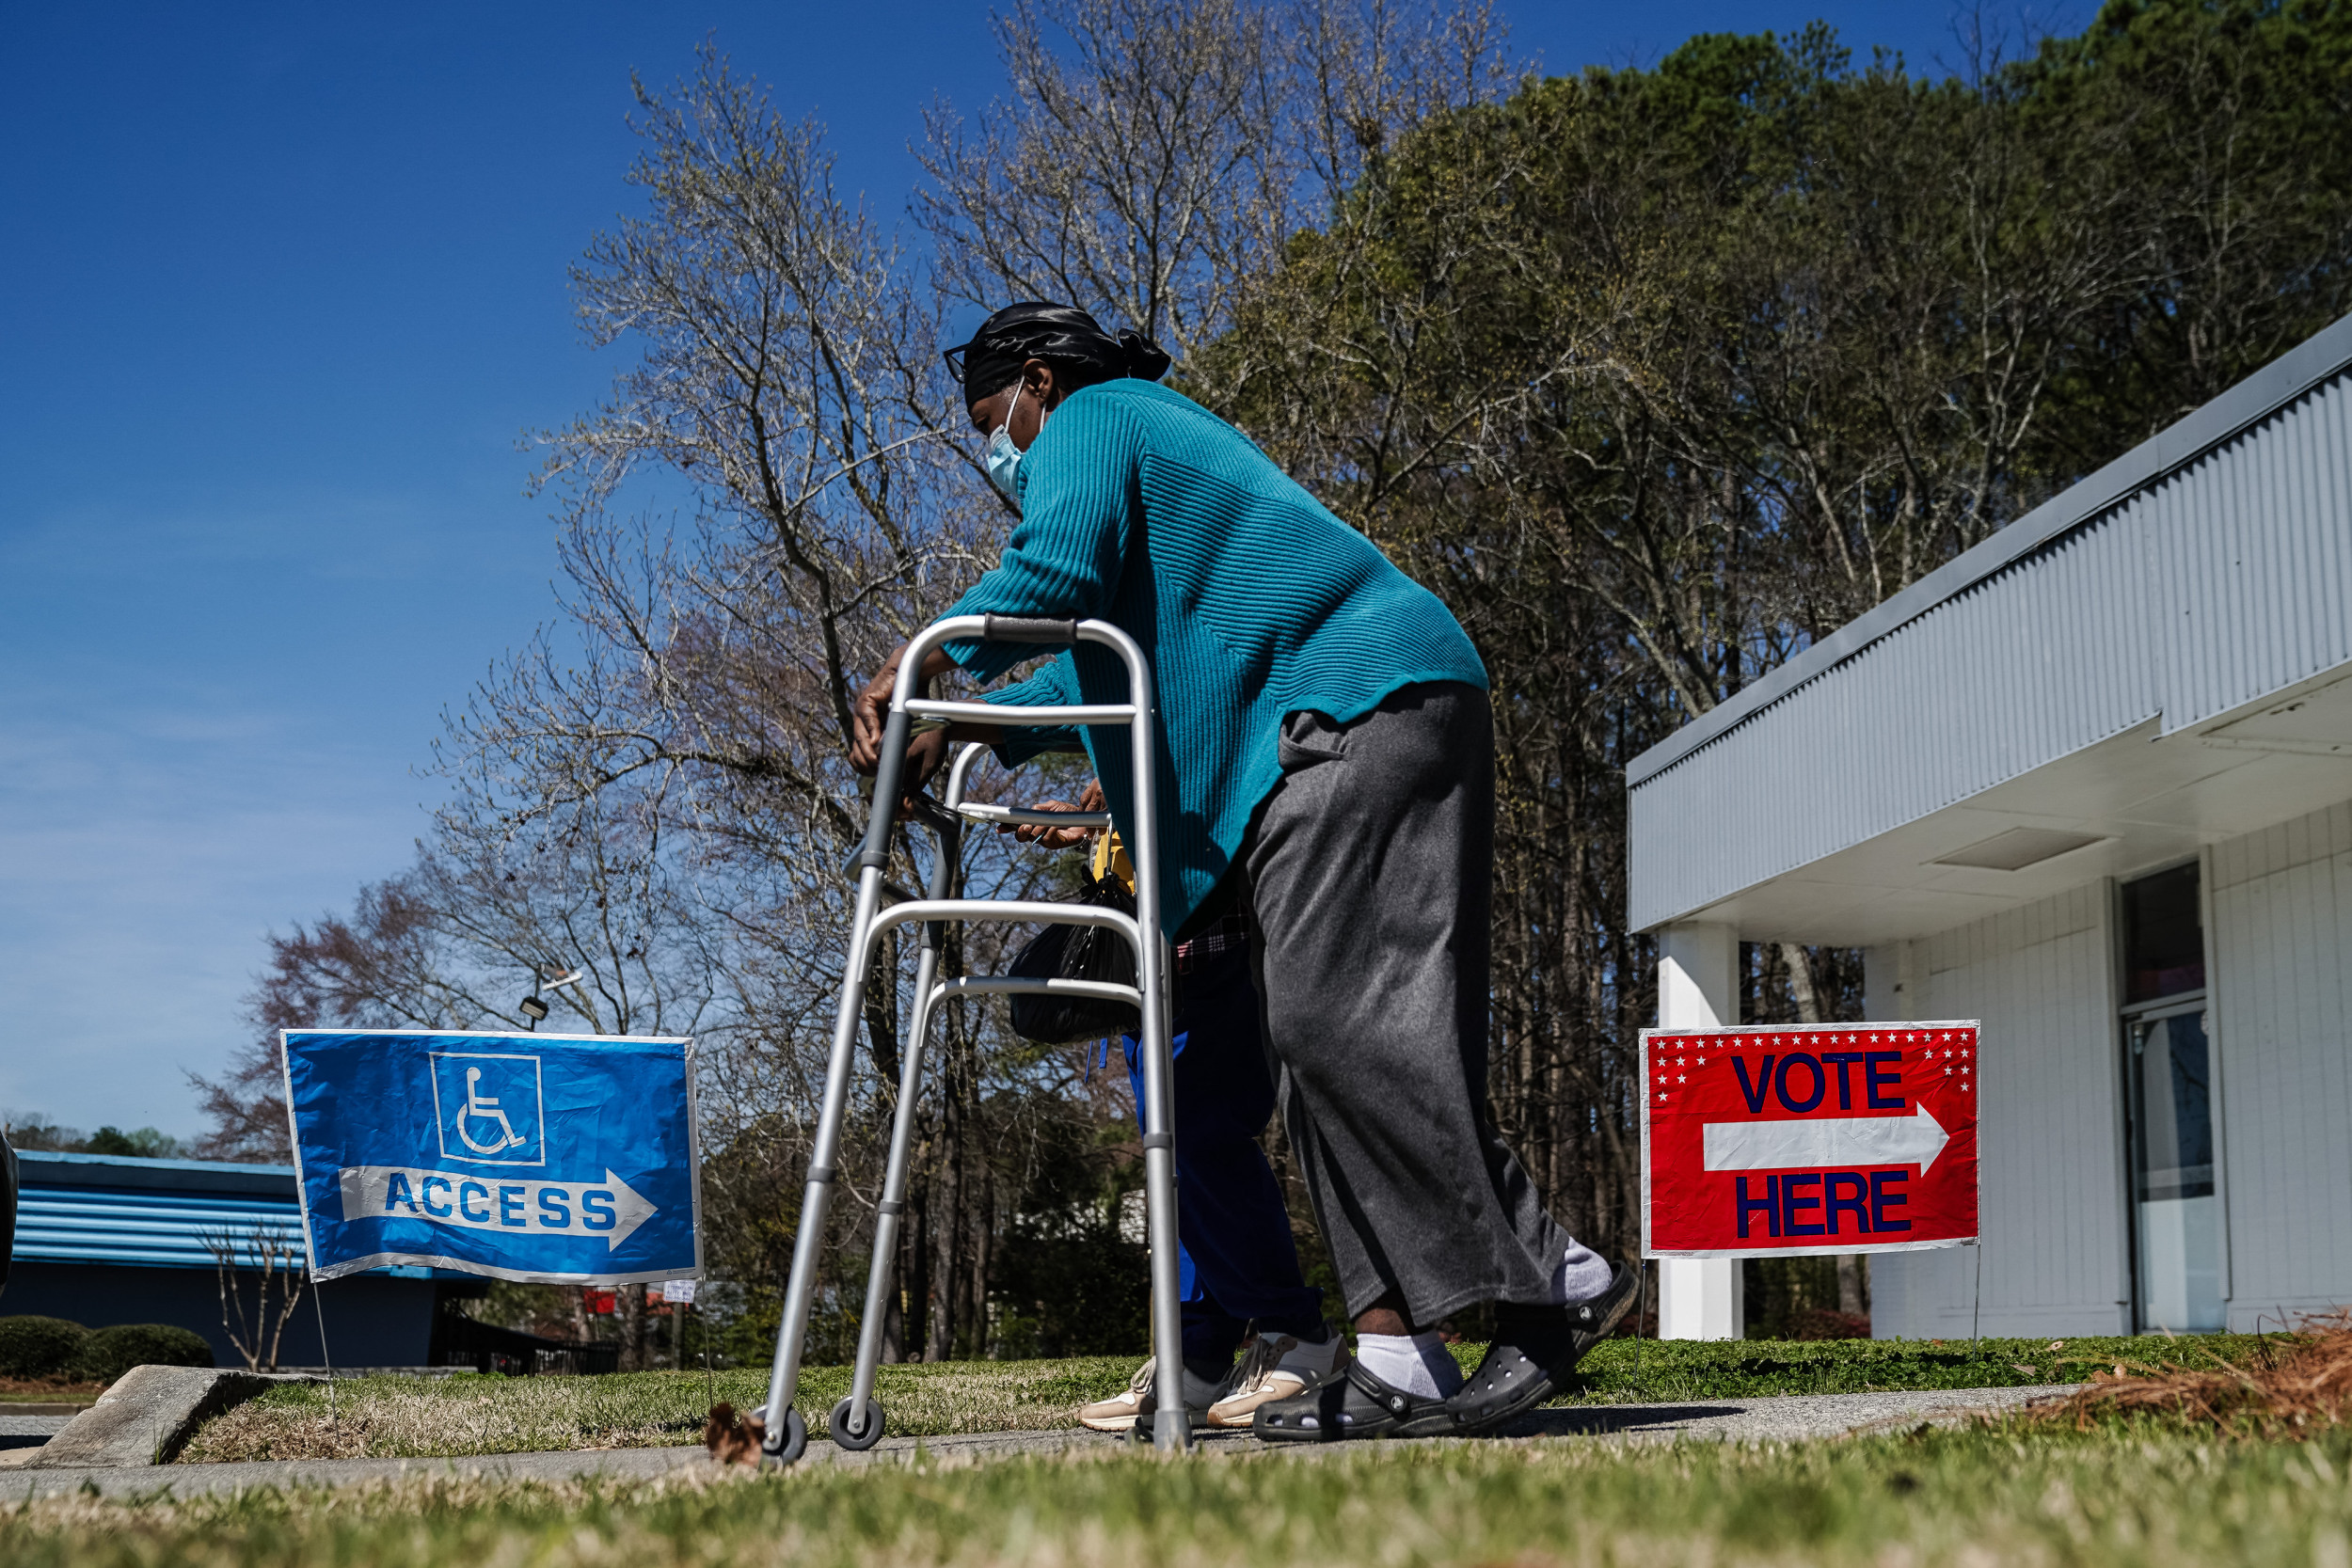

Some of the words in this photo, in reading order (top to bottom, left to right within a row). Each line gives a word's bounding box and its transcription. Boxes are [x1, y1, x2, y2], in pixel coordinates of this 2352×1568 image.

[1731, 1052, 1905, 1114] VOTE
[385, 1173, 616, 1231] ACCESS
[1737, 1170, 1912, 1239] HERE
